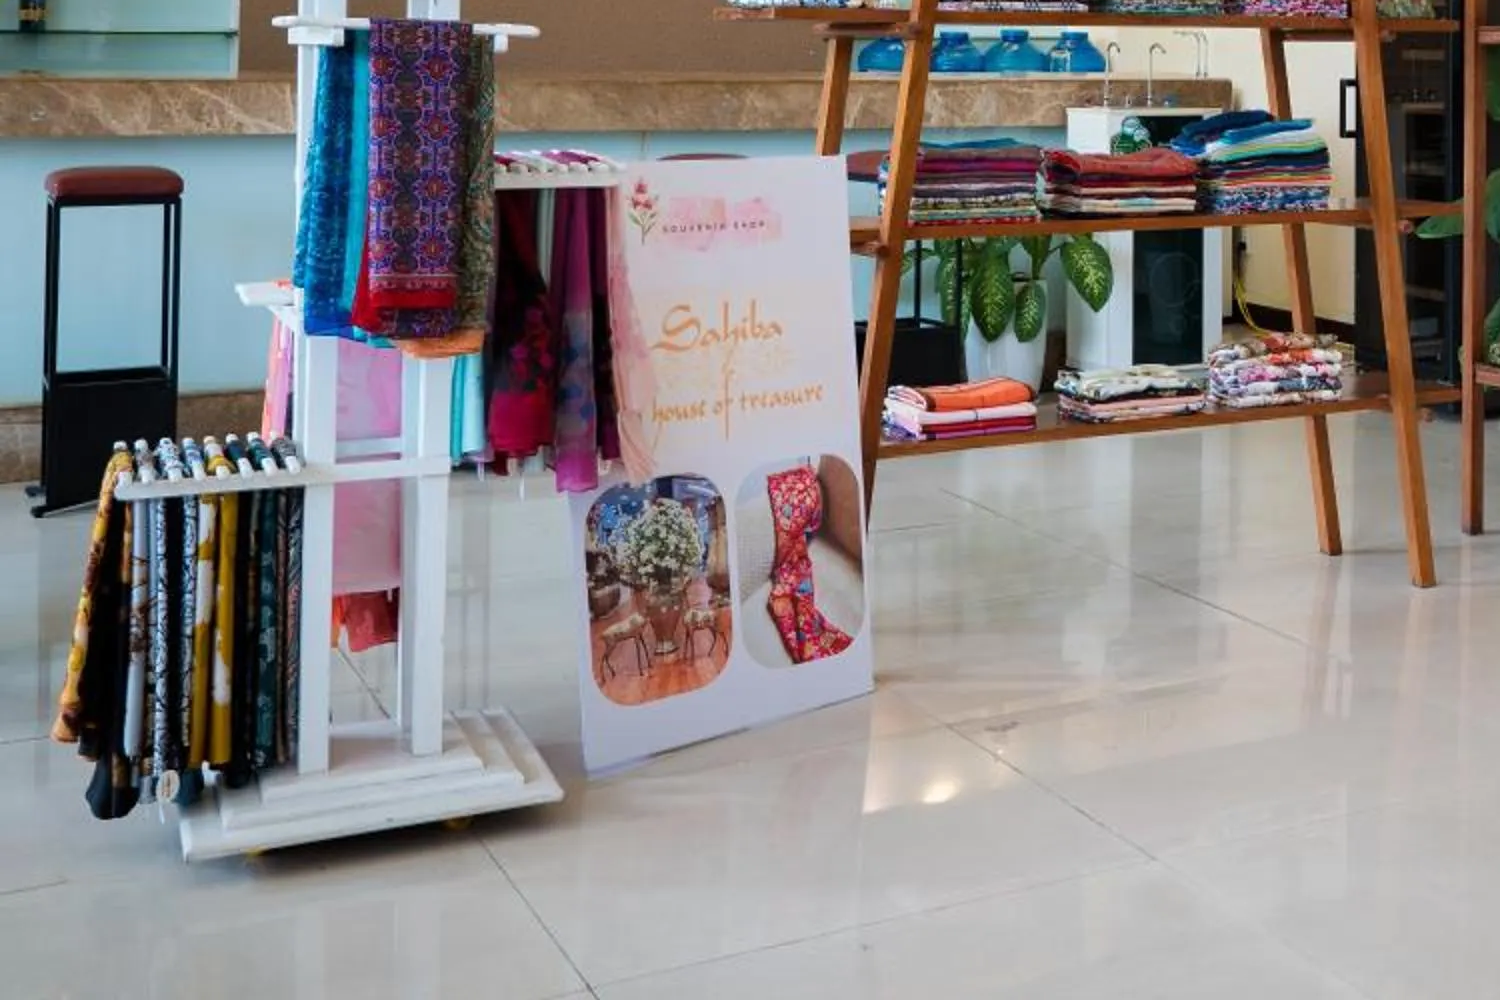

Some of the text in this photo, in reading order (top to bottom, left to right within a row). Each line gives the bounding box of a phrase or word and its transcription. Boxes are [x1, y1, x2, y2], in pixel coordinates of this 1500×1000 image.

[651, 298, 783, 362] Sahiba
[652, 367, 824, 445] house of treasure
